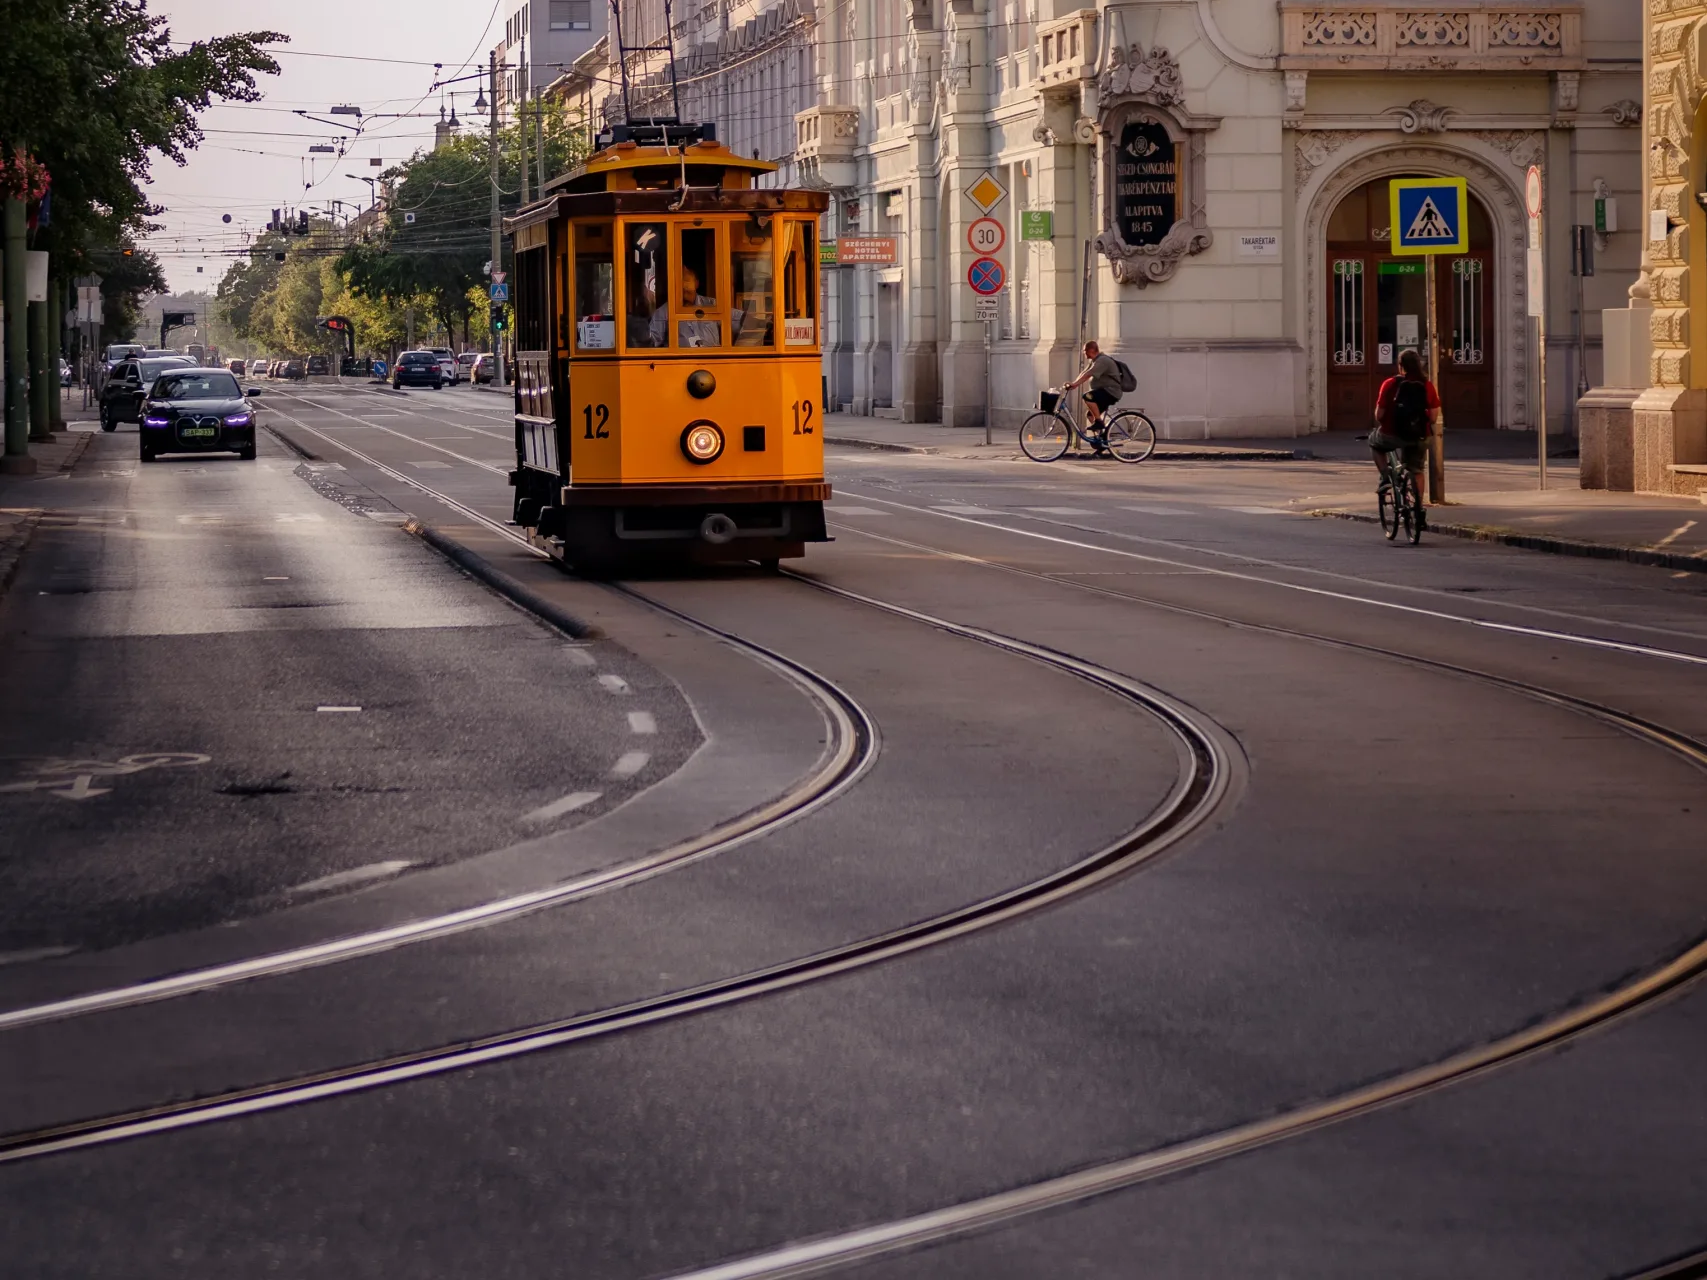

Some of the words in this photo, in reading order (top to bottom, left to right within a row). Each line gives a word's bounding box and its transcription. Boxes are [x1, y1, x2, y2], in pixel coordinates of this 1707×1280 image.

[1028, 227, 1044, 235] 0-24
[1131, 221, 1153, 232] 1845
[978, 229, 994, 244] 30
[1399, 265, 1415, 273] 0-24
[977, 311, 987, 319] 70
[583, 404, 610, 439] 12
[792, 399, 814, 435] 12
